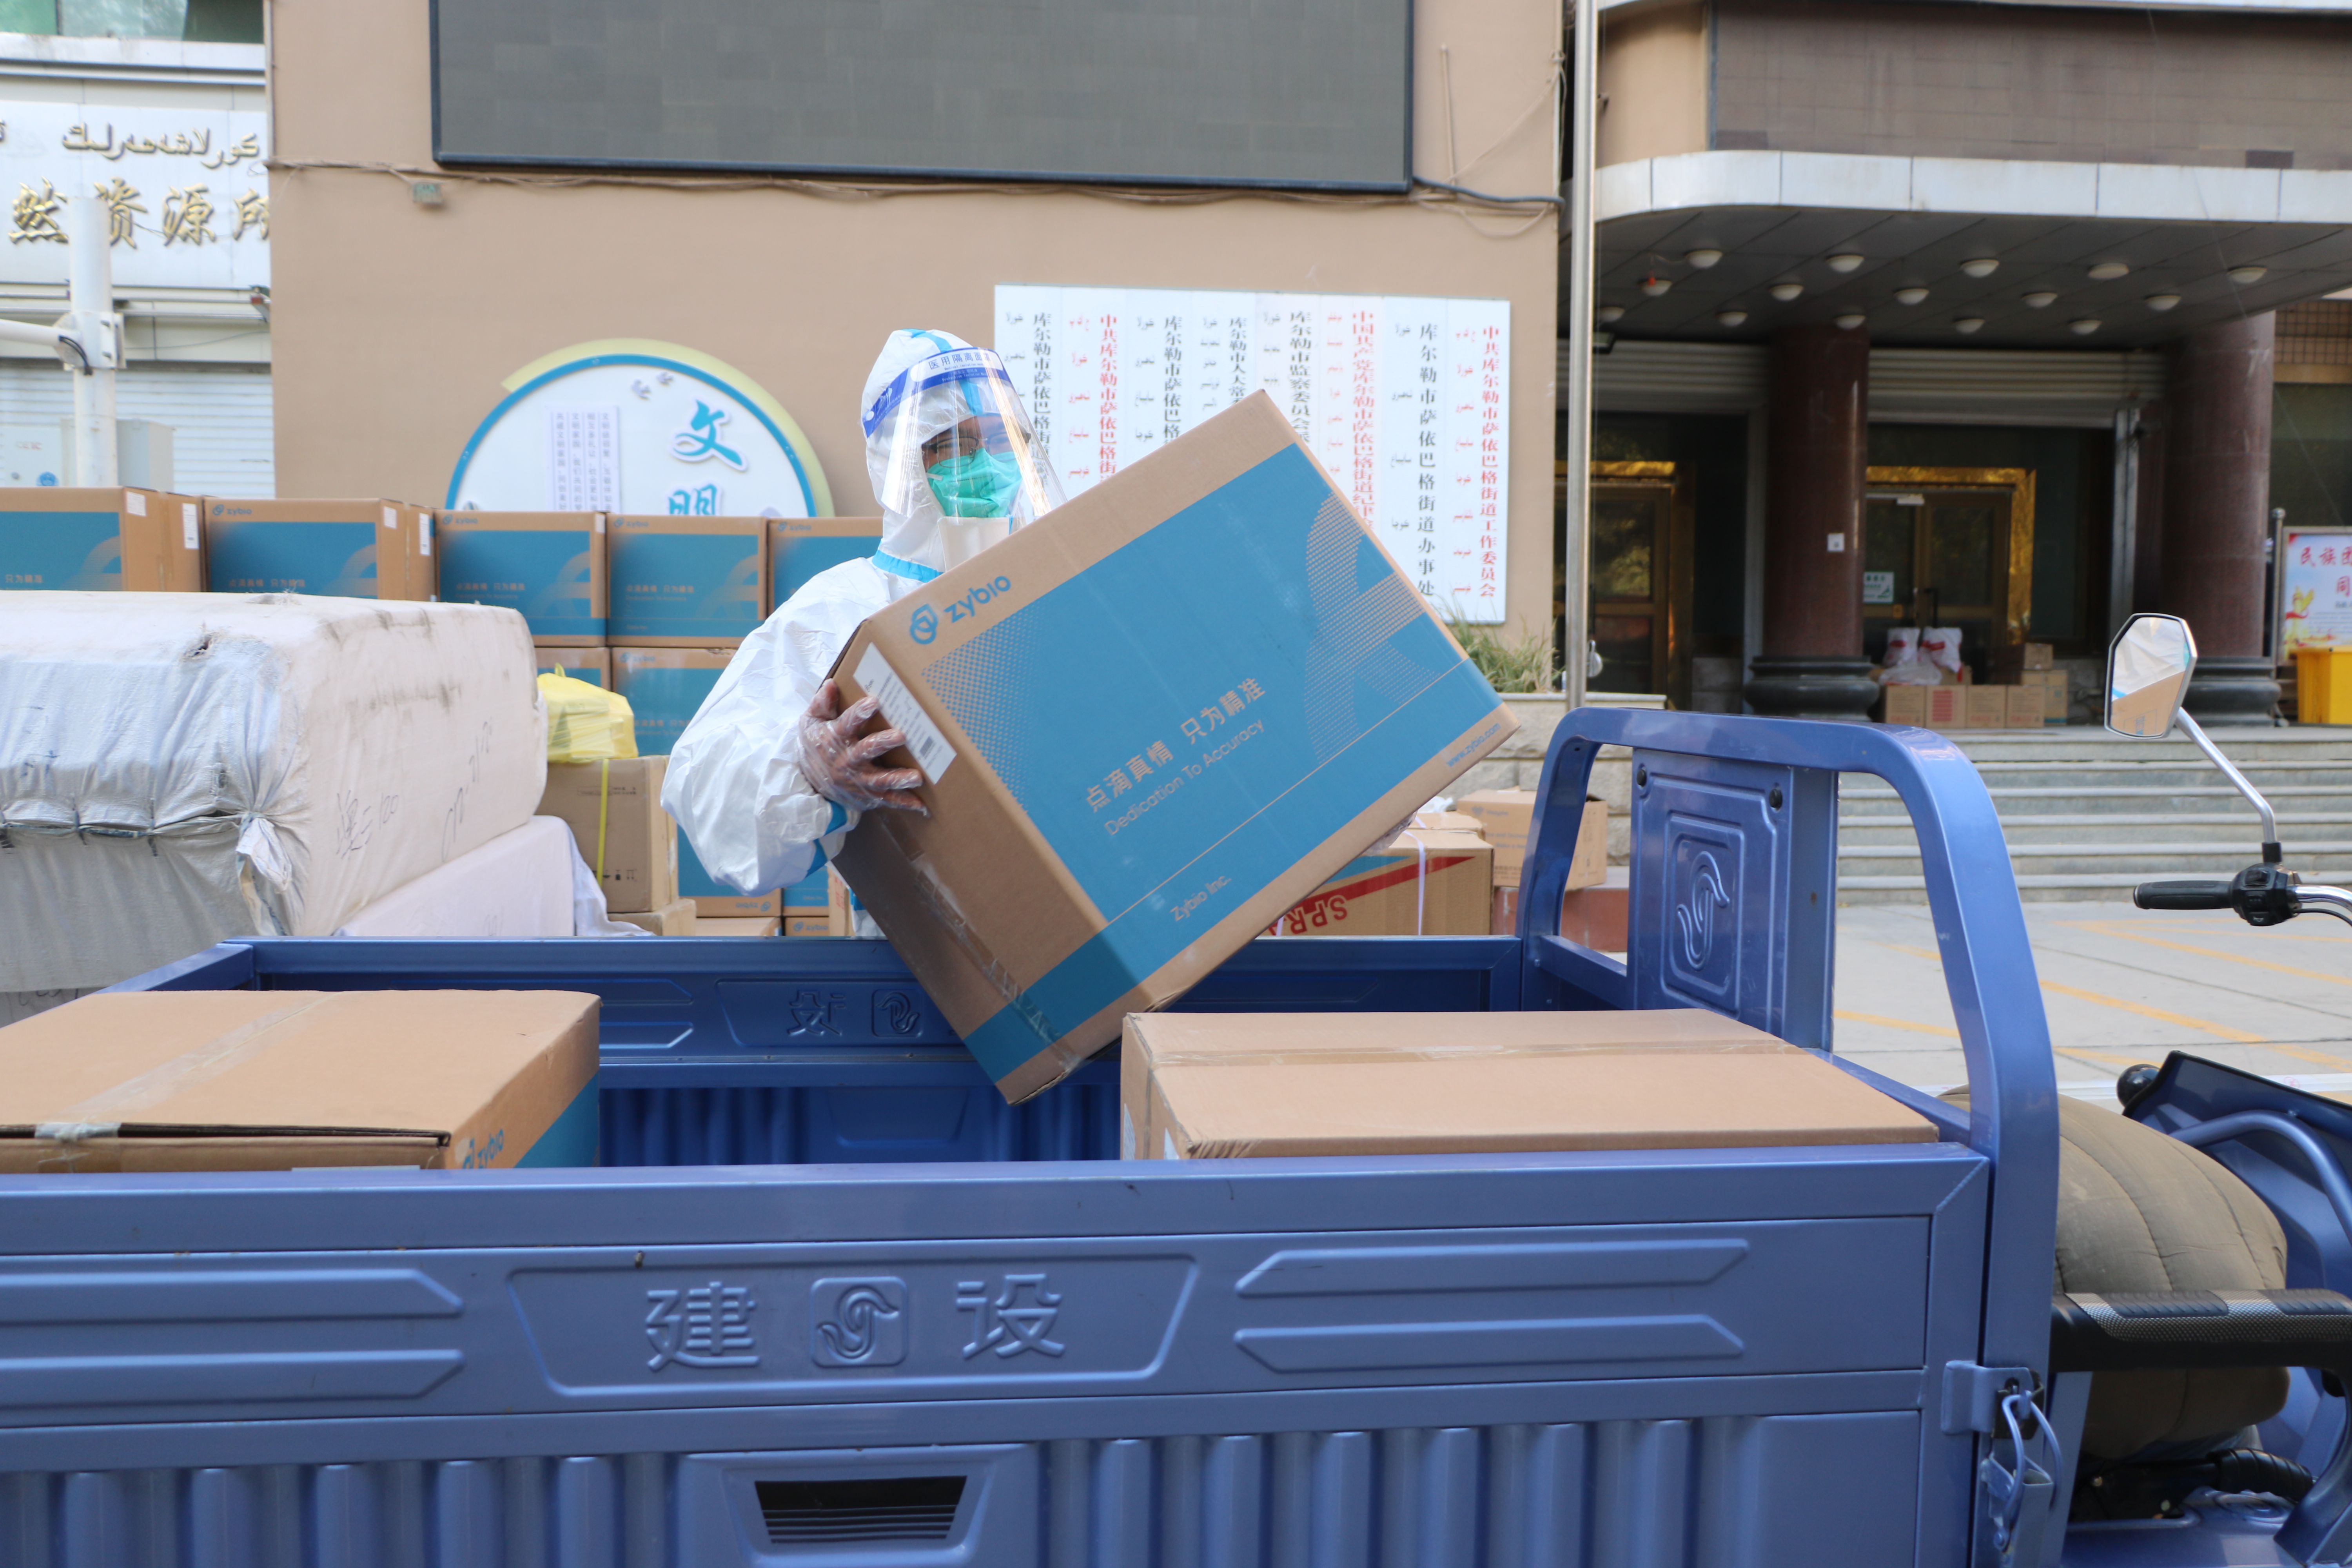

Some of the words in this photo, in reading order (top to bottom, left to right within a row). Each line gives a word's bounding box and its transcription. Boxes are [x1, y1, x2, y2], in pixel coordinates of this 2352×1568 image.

[1099, 314, 1117, 481] 中共库尔勒市萨依巴格街
[1164, 316, 1181, 444] 库尔勒市萨依巴格
[1418, 323, 1438, 596] 库尔勒市萨依巴格街道办事处
[1480, 326, 1499, 597] 中共库尔勒市萨依巴格街道工作委员会
[944, 575, 1011, 624] zybio
[1086, 740, 1173, 812] 点滴真情
[1180, 677, 1265, 744] 只为精准
[1104, 775, 1185, 835] Dedication
[1182, 764, 1202, 779] To
[1203, 719, 1265, 768] Accuracy
[1446, 722, 1502, 767] www.zybio.com
[1170, 892, 1208, 922] Zybio
[1205, 875, 1232, 895] Inc.
[645, 1280, 761, 1372] 建
[956, 1273, 1065, 1360] 设
